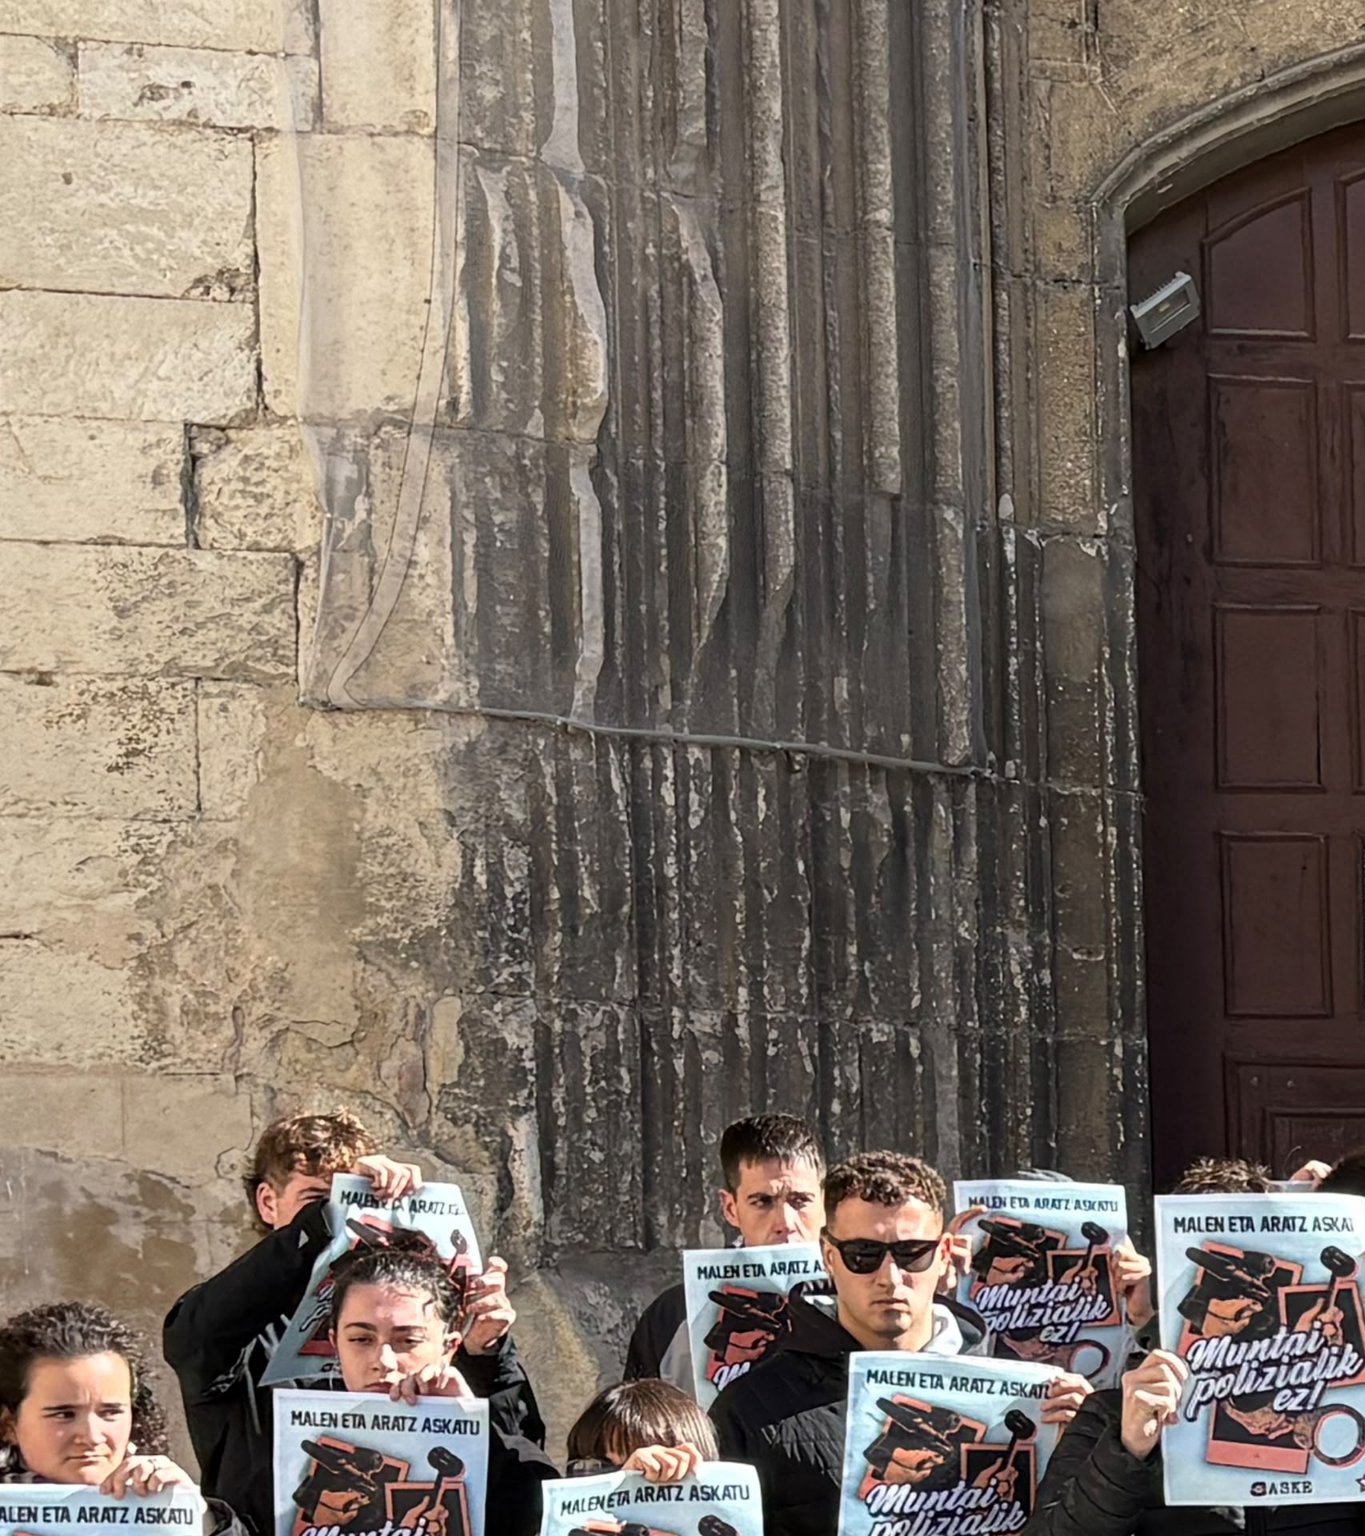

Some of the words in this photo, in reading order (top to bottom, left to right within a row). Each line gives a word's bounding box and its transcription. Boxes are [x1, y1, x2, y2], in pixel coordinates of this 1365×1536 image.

[1173, 1216, 1224, 1234] MALEN
[1228, 1216, 1255, 1233] ETA
[1259, 1216, 1307, 1233] ARATZ
[1311, 1217, 1355, 1233] ASKA
[697, 1265, 740, 1280] MALEN
[742, 1264, 766, 1278] ETA
[770, 1261, 810, 1276] ARATZ
[976, 1276, 1082, 1309] Muntai
[1041, 1321, 1080, 1343] ez!
[1186, 1321, 1325, 1370] Muntai
[867, 1368, 917, 1387] MALEN
[919, 1372, 945, 1390] ETA
[949, 1376, 996, 1395] ARATZ
[1187, 1343, 1363, 1420] polizialik
[1275, 1380, 1324, 1410] ez!
[292, 1411, 338, 1428] MALEN
[342, 1413, 367, 1429] ETA
[371, 1415, 416, 1432] ARATZ
[421, 1417, 479, 1435] ASKATU
[561, 1495, 601, 1516] MALEN
[601, 1490, 629, 1509] ETA
[634, 1485, 685, 1504] ARATZ
[690, 1483, 751, 1502] ASKATU
[868, 1478, 997, 1514] Muntai
[1269, 1483, 1312, 1496] ASKE
[0, 1506, 38, 1523] ALEN
[43, 1507, 71, 1523] ETA
[77, 1507, 129, 1524] ARATZ
[135, 1509, 194, 1525] ASKATU
